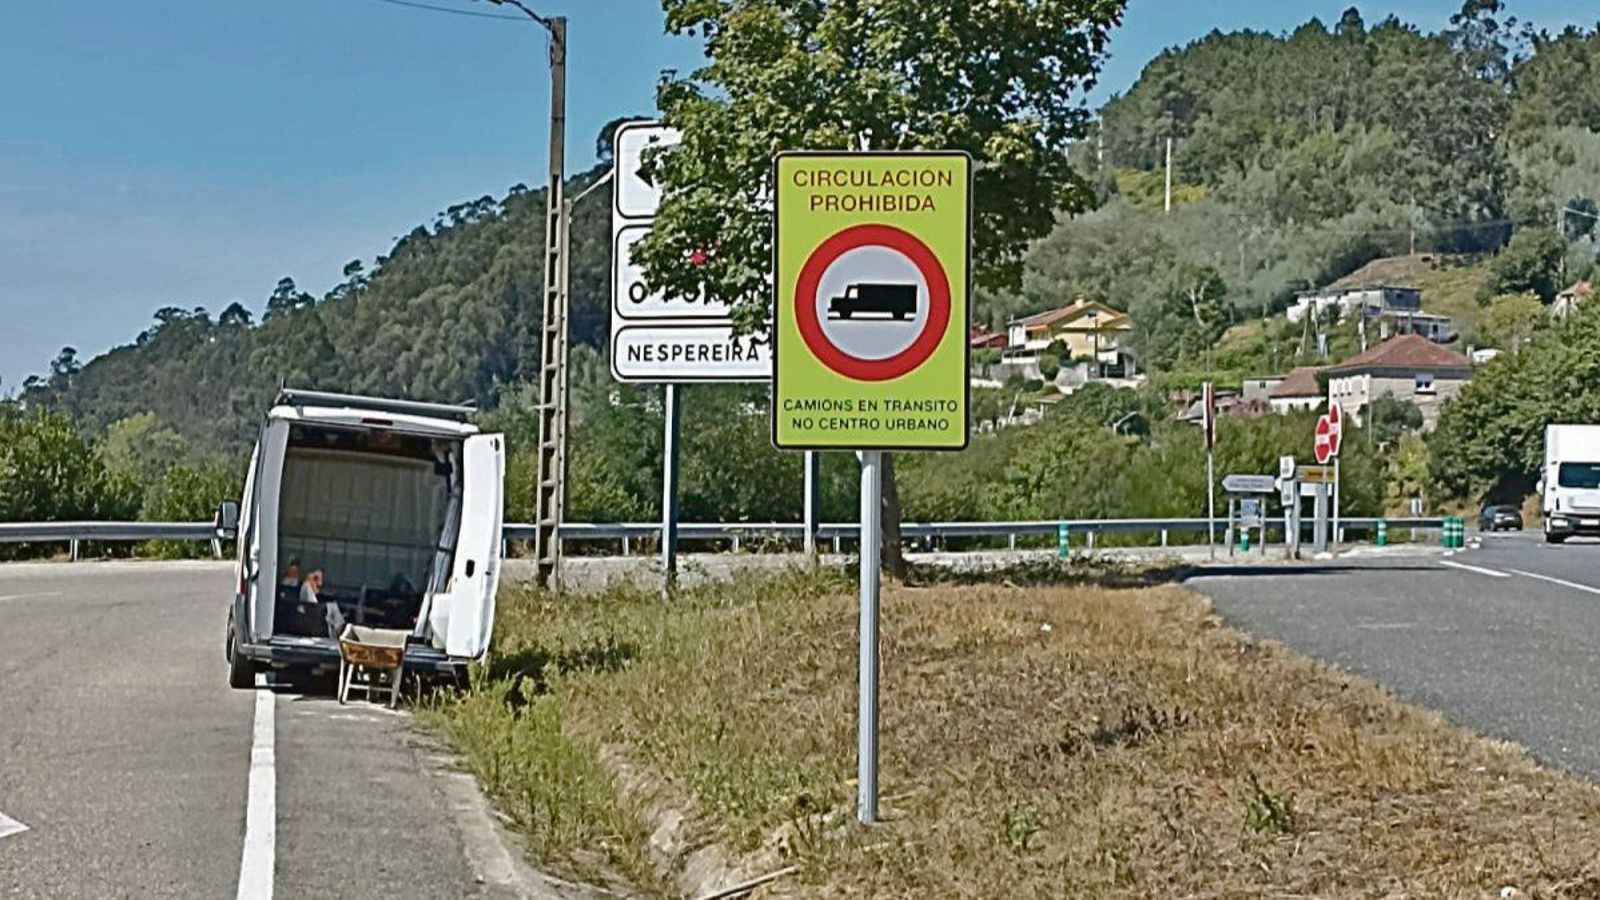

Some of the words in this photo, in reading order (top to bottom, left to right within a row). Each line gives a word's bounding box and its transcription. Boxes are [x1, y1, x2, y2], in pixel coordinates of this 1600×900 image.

[793, 165, 952, 188] CIRCULACIÓN
[810, 194, 936, 212] PROHIBIDA
[629, 281, 648, 304] O
[628, 344, 759, 362] NESPEREIRA
[858, 400, 878, 412] EN
[792, 417, 814, 430] NO
[818, 417, 880, 430] CENTRO
[885, 417, 949, 431] URBANO
